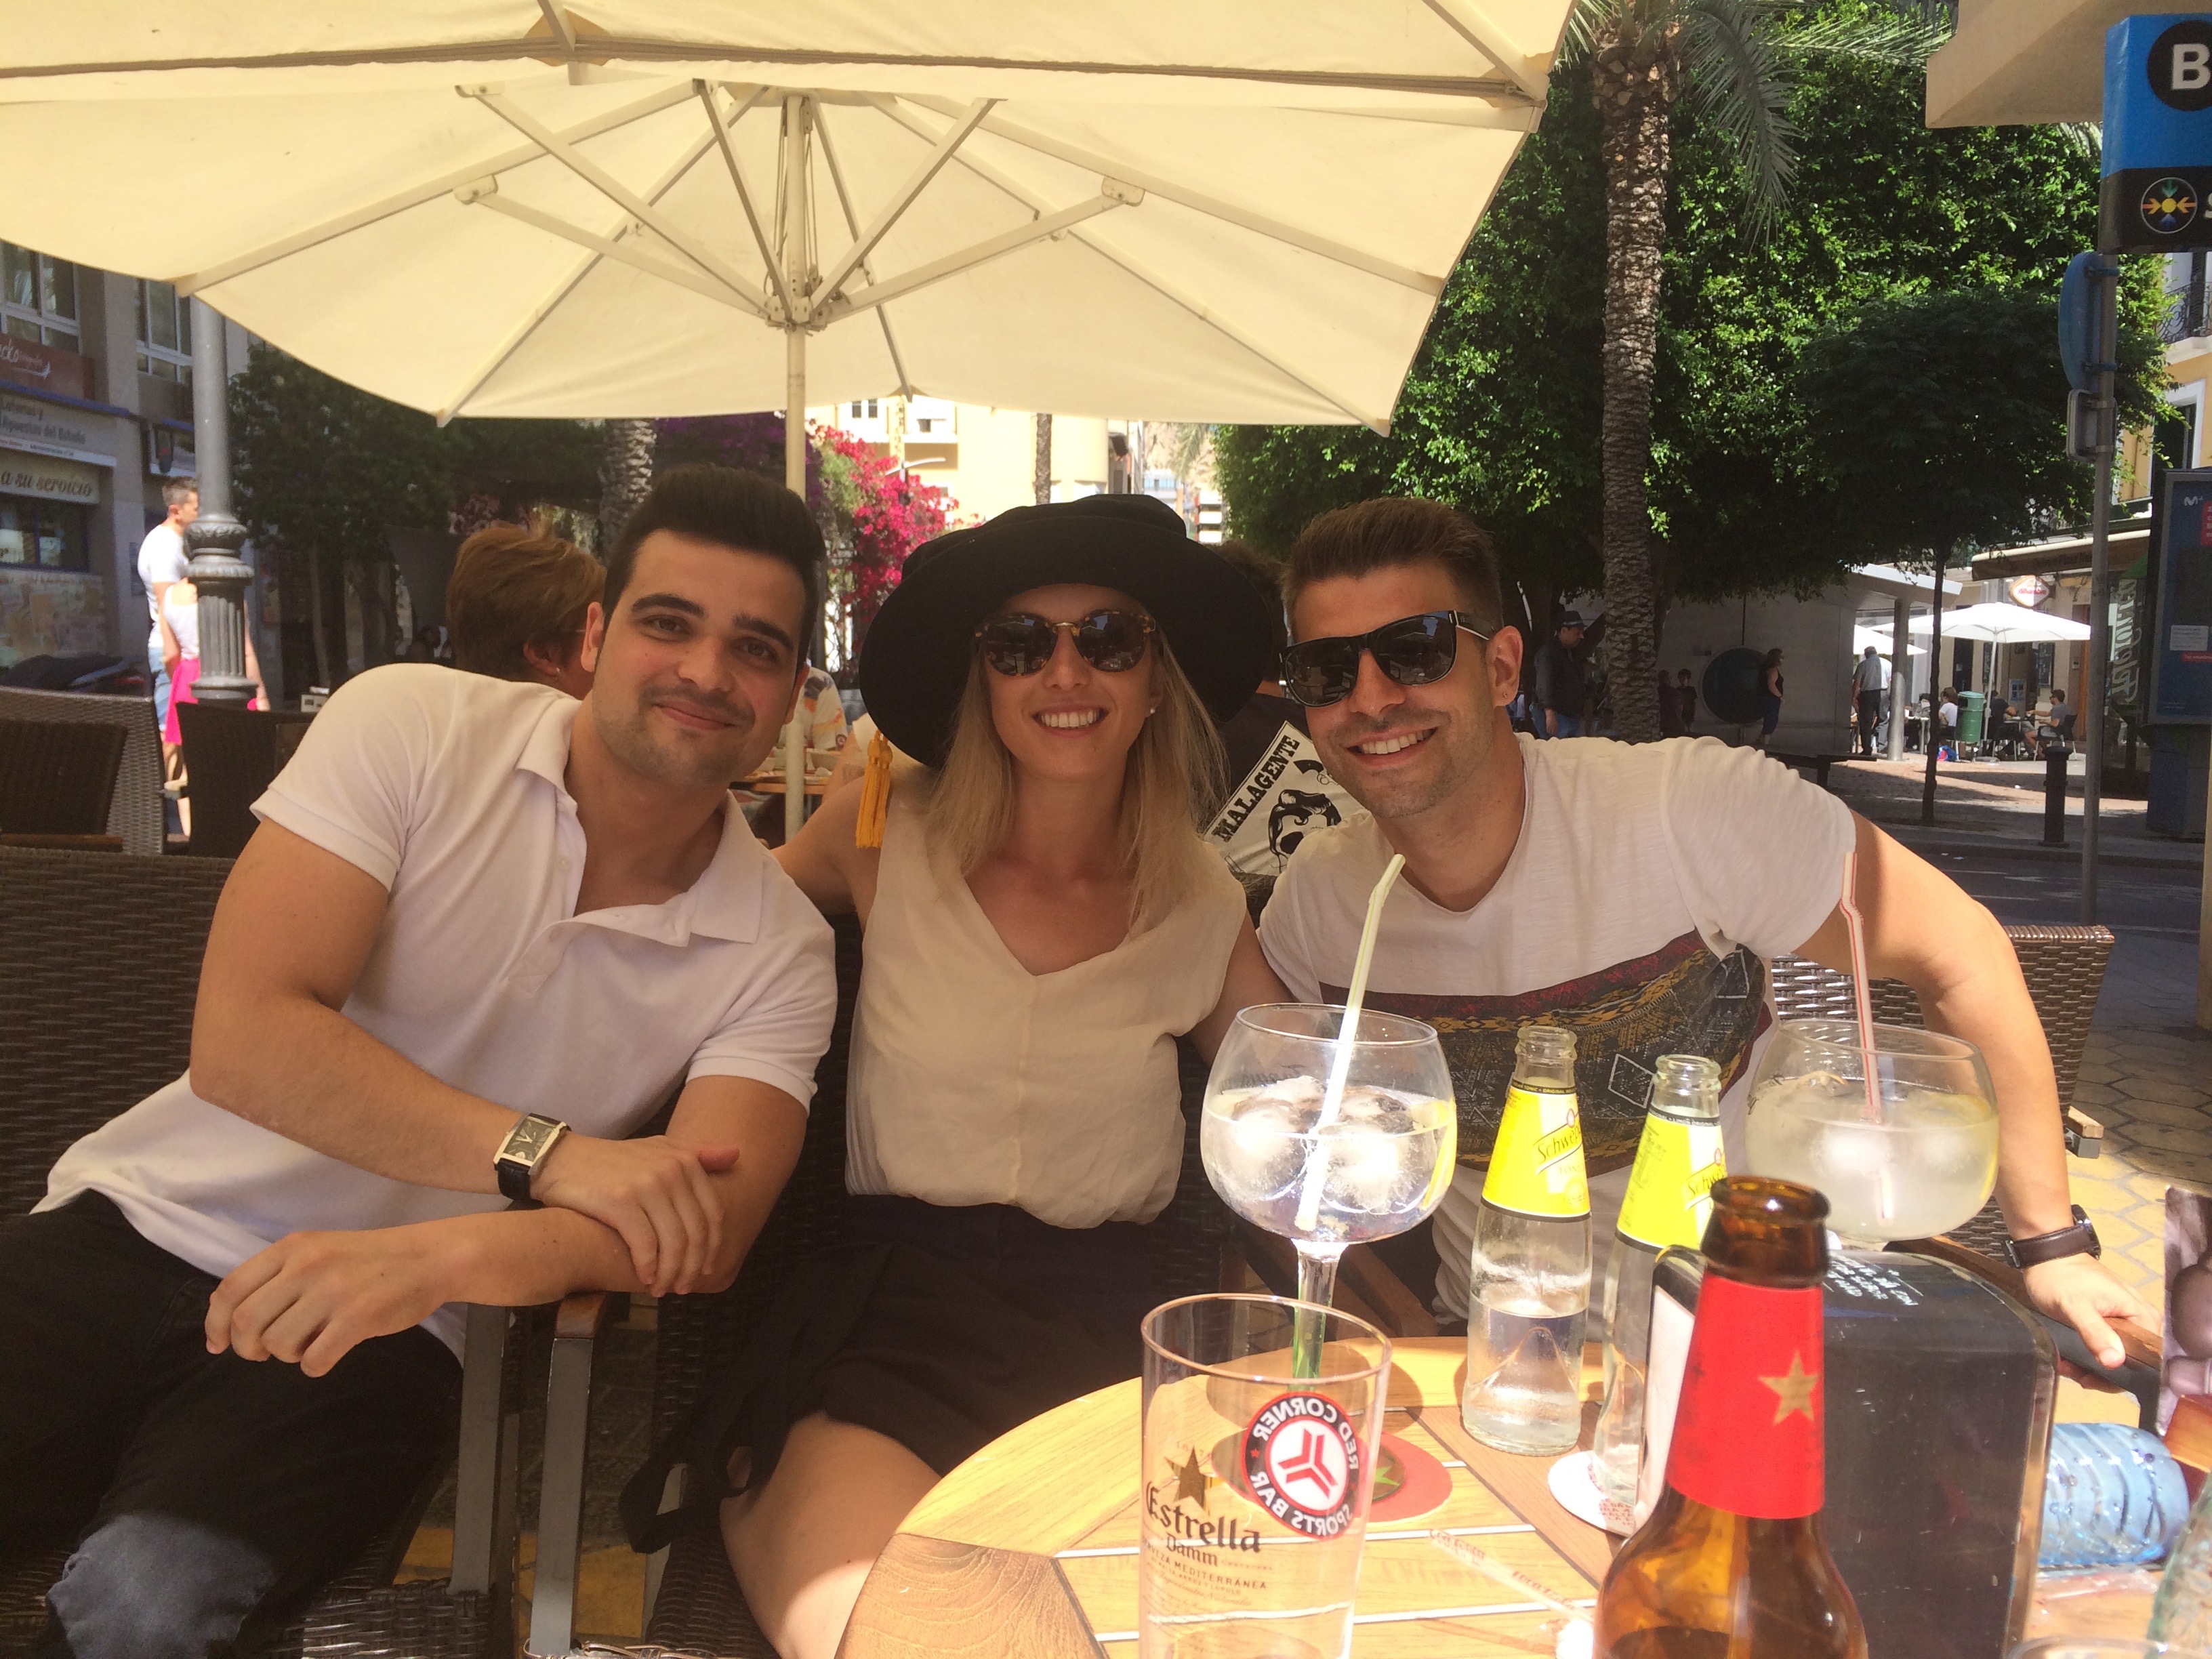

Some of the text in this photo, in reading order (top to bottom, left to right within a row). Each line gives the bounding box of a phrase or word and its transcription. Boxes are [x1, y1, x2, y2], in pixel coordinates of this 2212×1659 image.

[15, 473, 33, 489] su
[36, 476, 91, 497] servicio
[1211, 735, 1300, 842] MALAGENTE
[1146, 1481, 1261, 1553] Estrella
[1166, 1532, 1218, 1568] Damm
